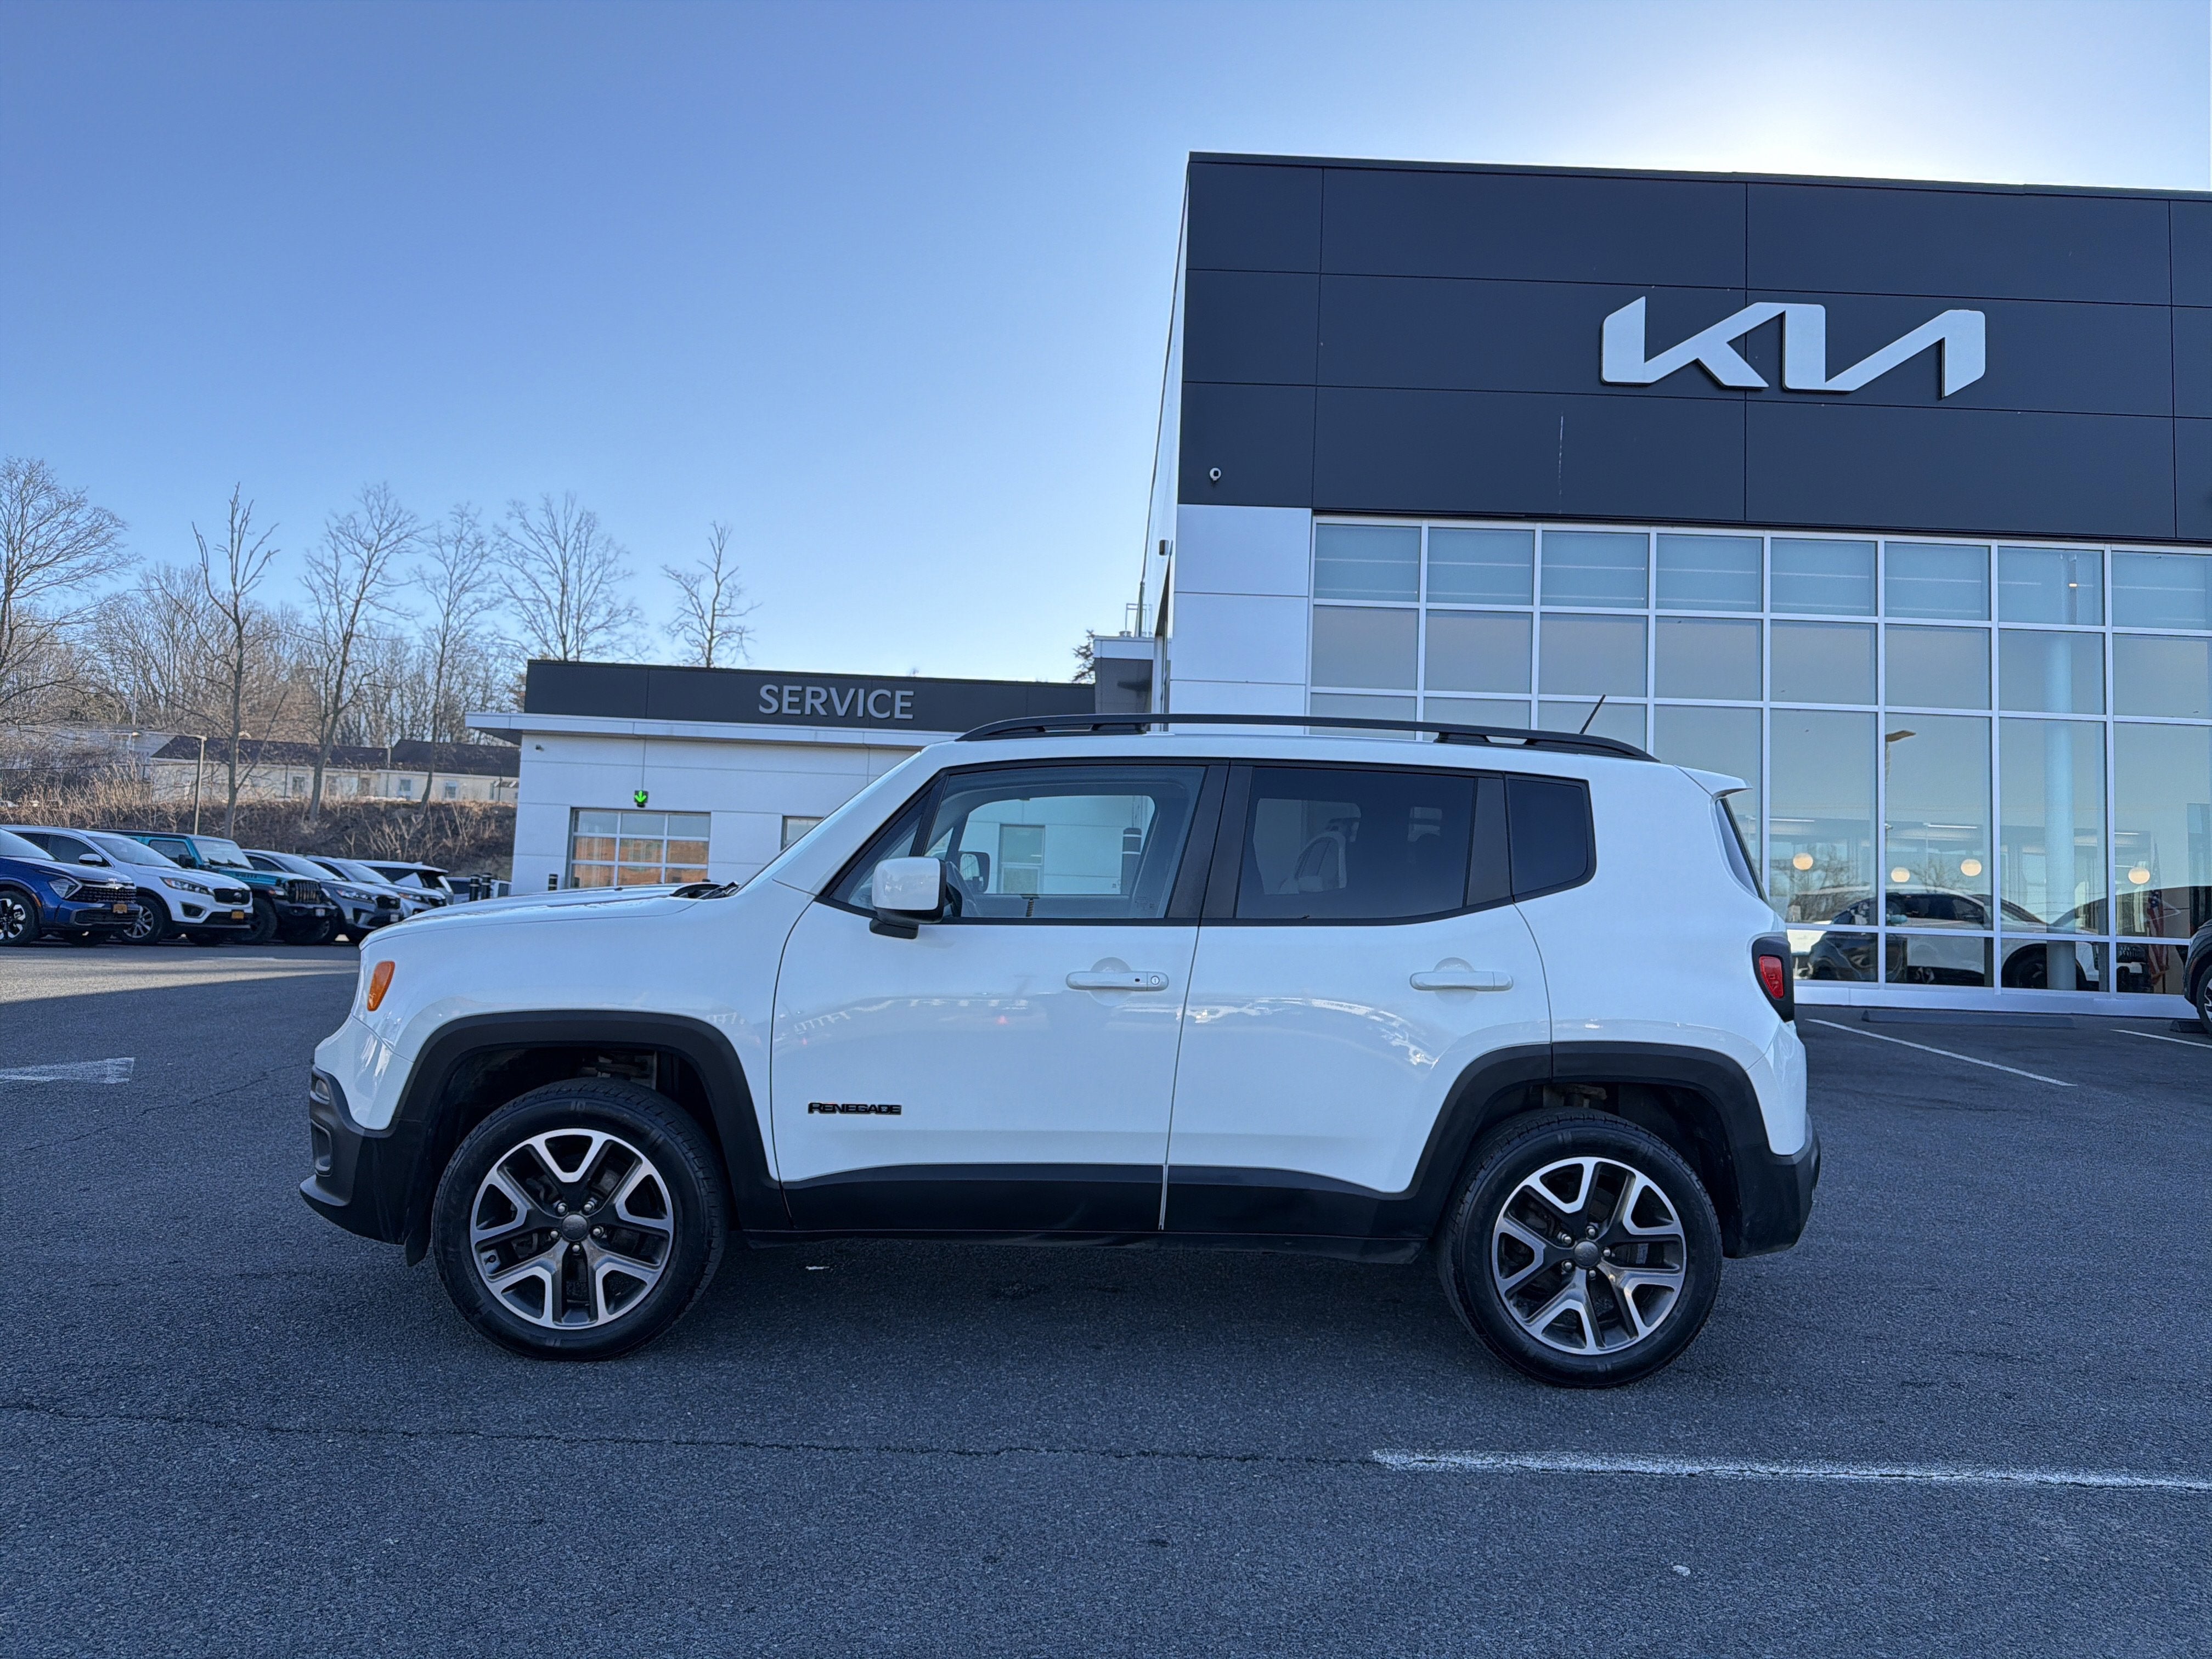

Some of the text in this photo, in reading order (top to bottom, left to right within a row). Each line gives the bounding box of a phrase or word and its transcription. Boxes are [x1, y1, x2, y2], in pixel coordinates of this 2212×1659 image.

[1601, 296, 1985, 399] KIA
[759, 684, 915, 719] SERVICE
[808, 1102, 901, 1115] RENEGADE
